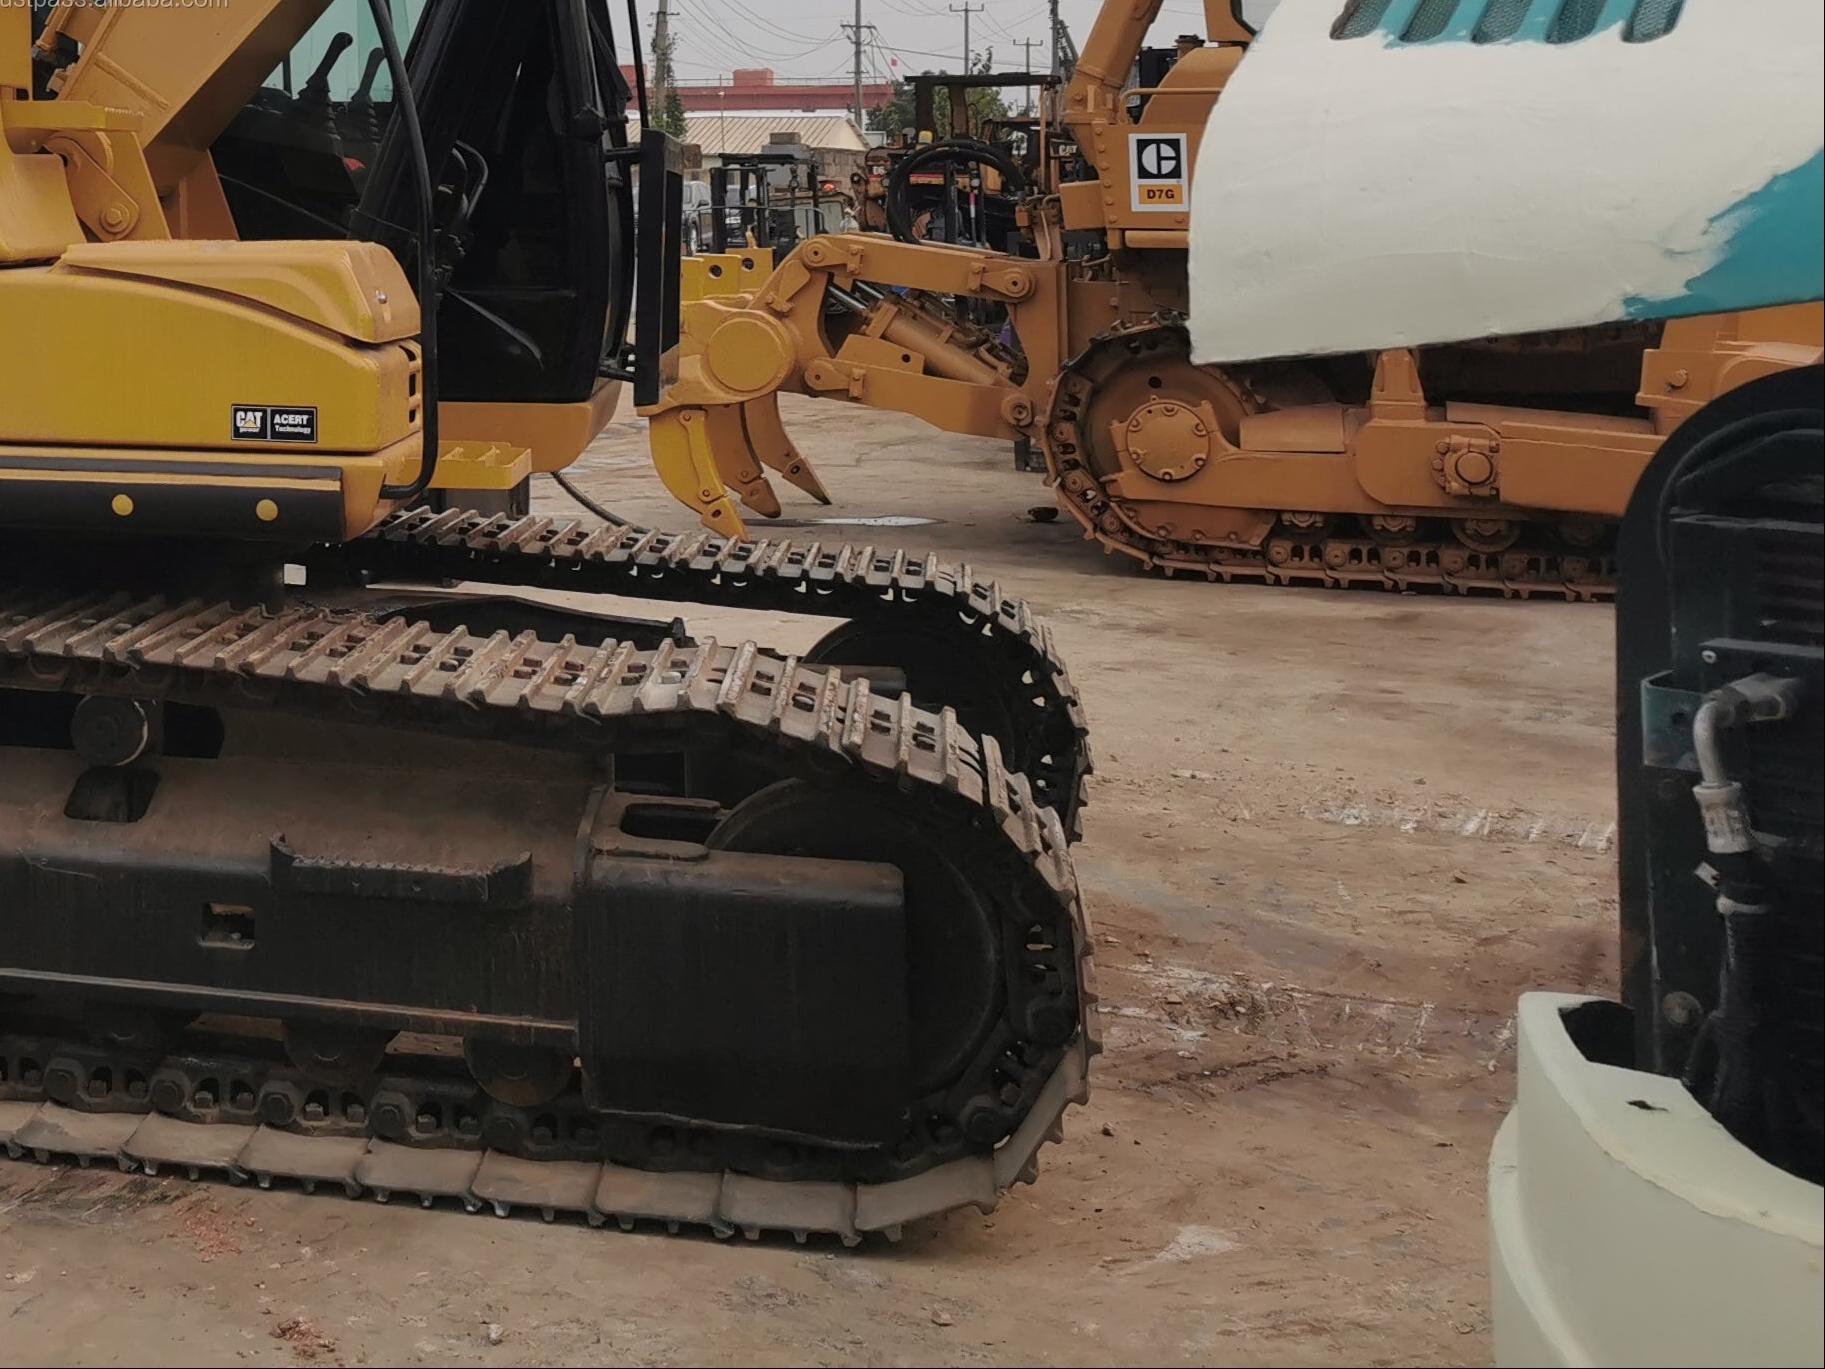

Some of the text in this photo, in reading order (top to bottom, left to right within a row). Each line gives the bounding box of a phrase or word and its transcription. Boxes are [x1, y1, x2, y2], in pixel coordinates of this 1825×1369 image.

[1146, 188, 1175, 200] D7G
[236, 411, 263, 427] CAT
[274, 414, 309, 425] ACERT
